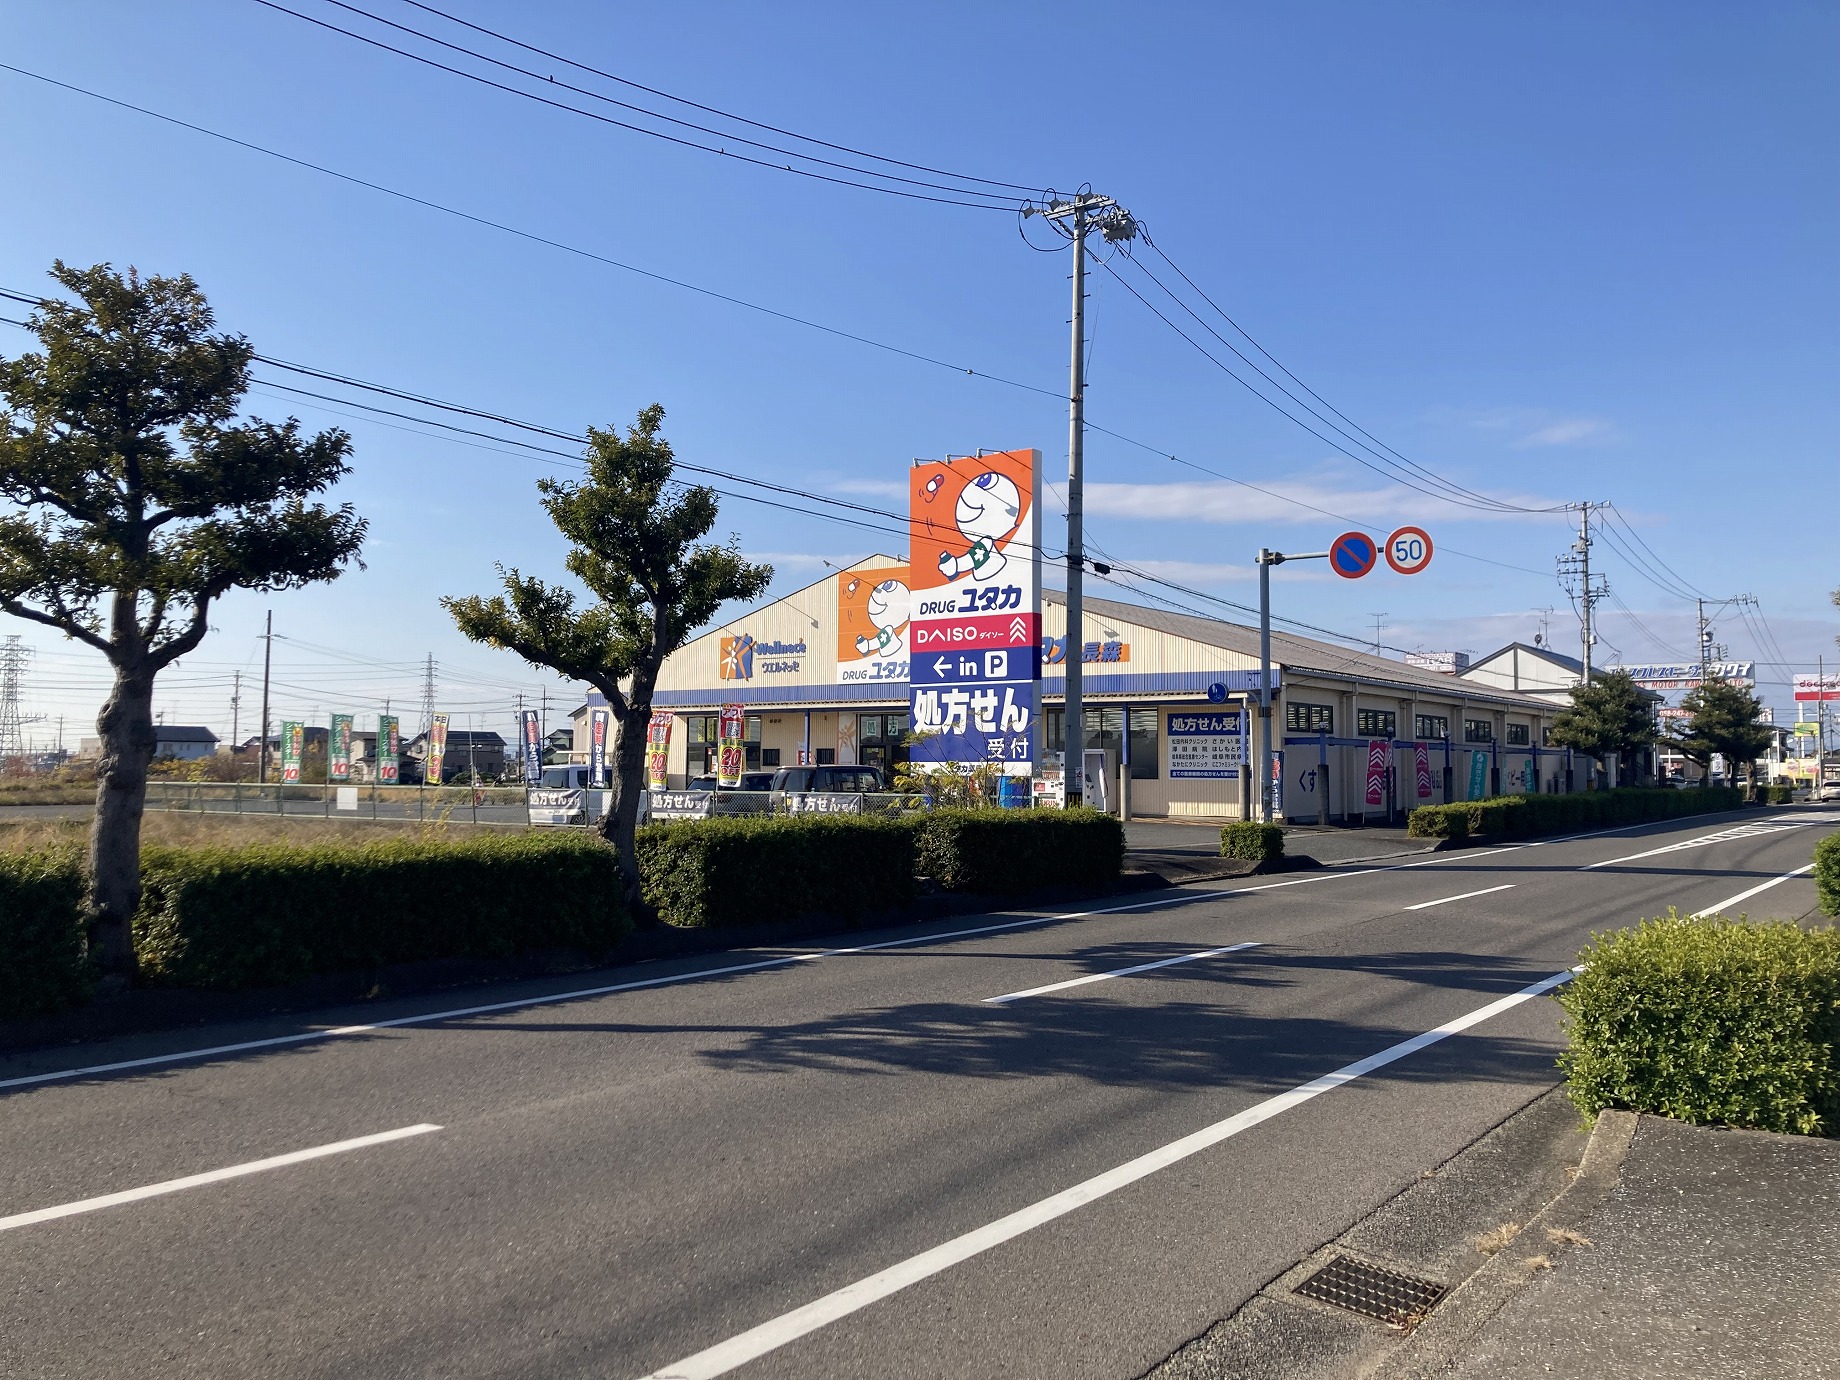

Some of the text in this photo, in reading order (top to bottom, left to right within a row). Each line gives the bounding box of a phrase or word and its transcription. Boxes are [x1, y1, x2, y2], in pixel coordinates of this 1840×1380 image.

[1395, 539, 1422, 562] 50
[919, 584, 1022, 615] DRUG ユタカ
[917, 626, 1005, 644] DAISO ダイソー
[842, 670, 868, 681] DRUG
[959, 653, 1005, 676] in P
[913, 687, 1029, 735] 処方せん
[987, 738, 1029, 760] 受付
[720, 767, 741, 777] OFF
[1299, 769, 1317, 792] くす
